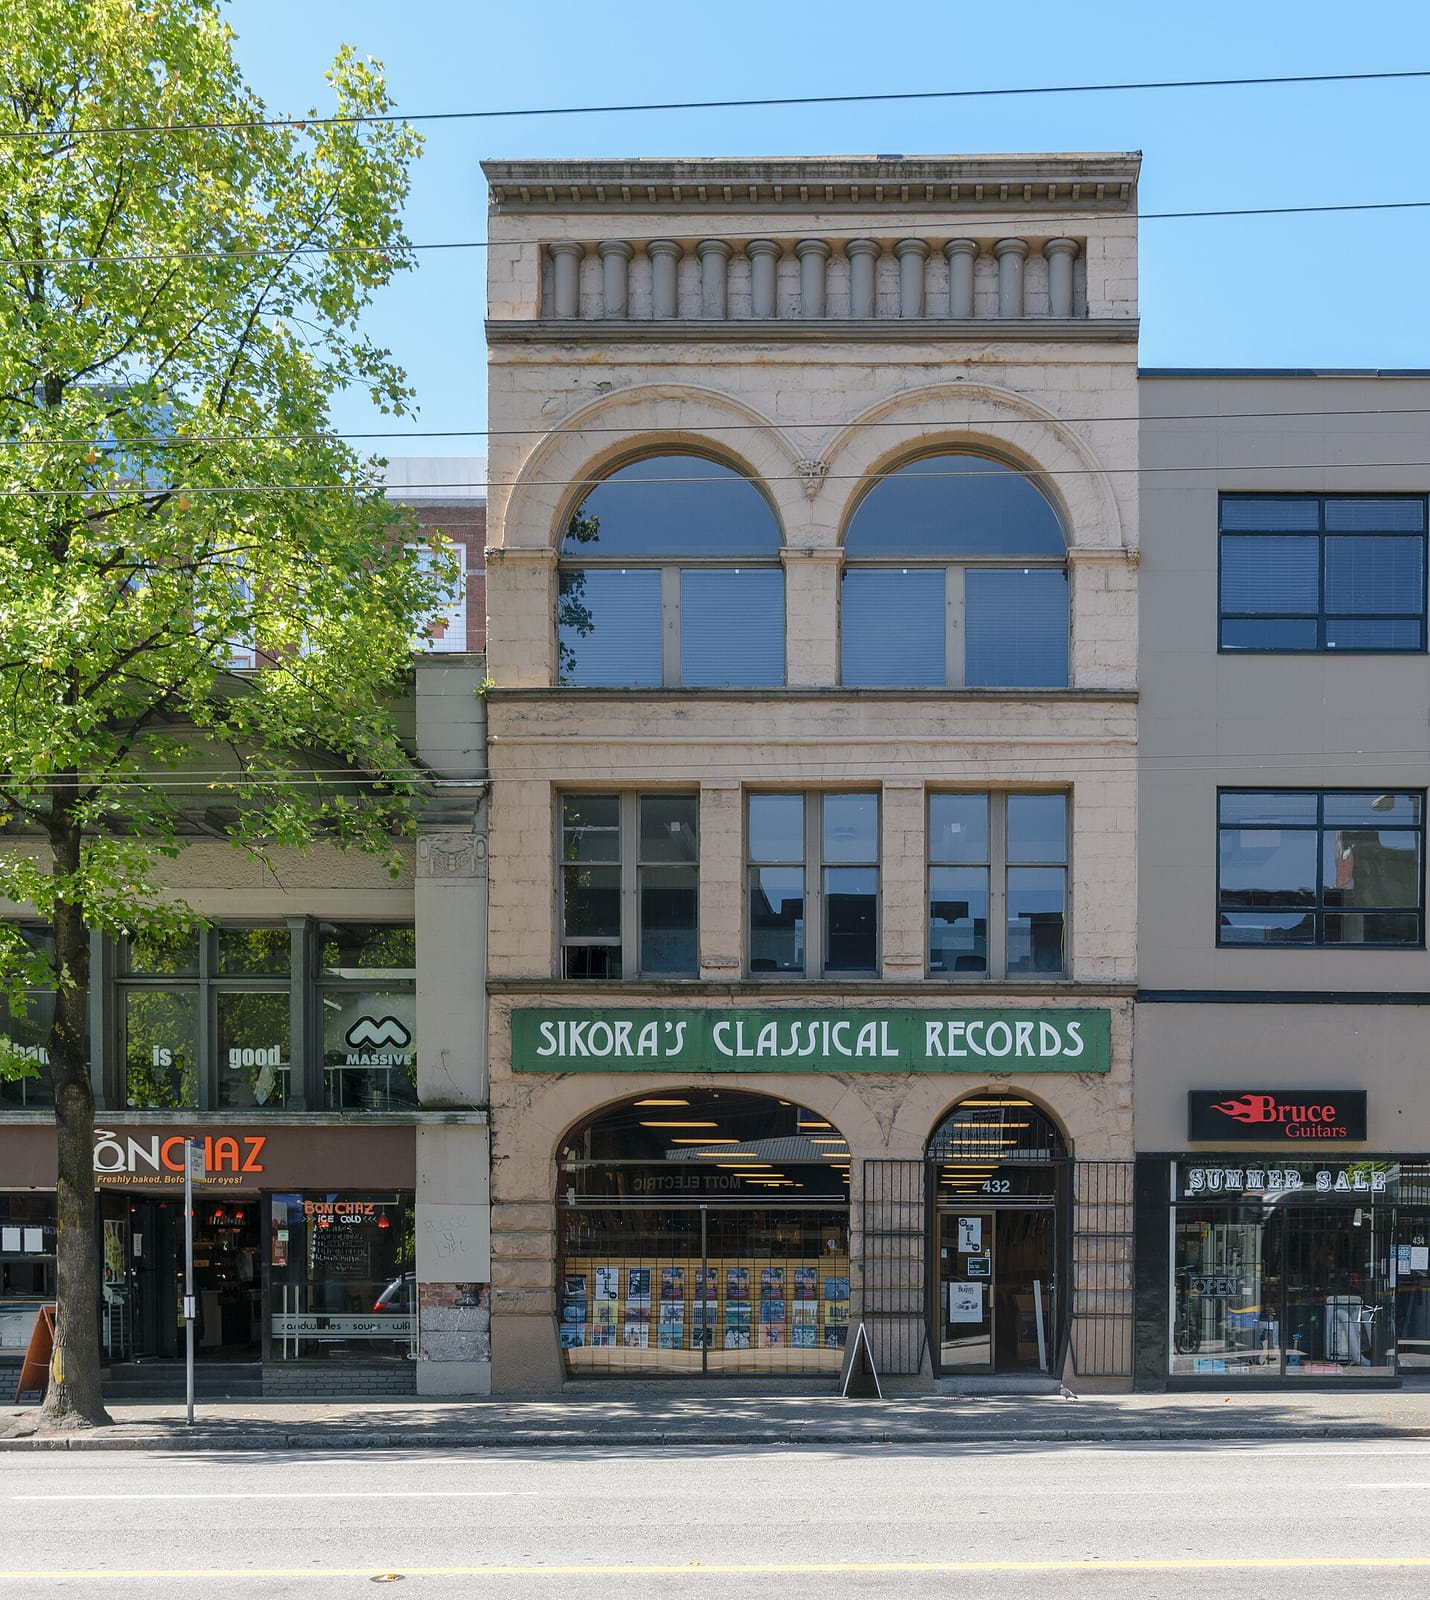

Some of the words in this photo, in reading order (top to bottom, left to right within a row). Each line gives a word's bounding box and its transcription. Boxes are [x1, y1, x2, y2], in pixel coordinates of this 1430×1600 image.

[536, 1021, 687, 1056] SIKORA'S
[712, 1021, 899, 1057] CLASSICAL
[925, 1021, 1084, 1057] RECORDS
[152, 1045, 172, 1067] is
[228, 1045, 281, 1069] good
[346, 1054, 412, 1065] MASSIVE
[1240, 1094, 1336, 1123] Bruce
[1285, 1123, 1348, 1138] Guitars
[97, 1175, 131, 1185] Freshly
[133, 1175, 162, 1184] baked.
[164, 1175, 187, 1184] Befo
[218, 1175, 243, 1185] eyes!
[982, 1180, 1010, 1193] 432
[1190, 1168, 1303, 1193] SUMMER
[1316, 1170, 1386, 1193] SALE
[340, 1215, 361, 1224] COLD
[1412, 1236, 1425, 1245] 434
[1192, 1279, 1237, 1295] OPEN
[392, 1321, 410, 1331] wifi
